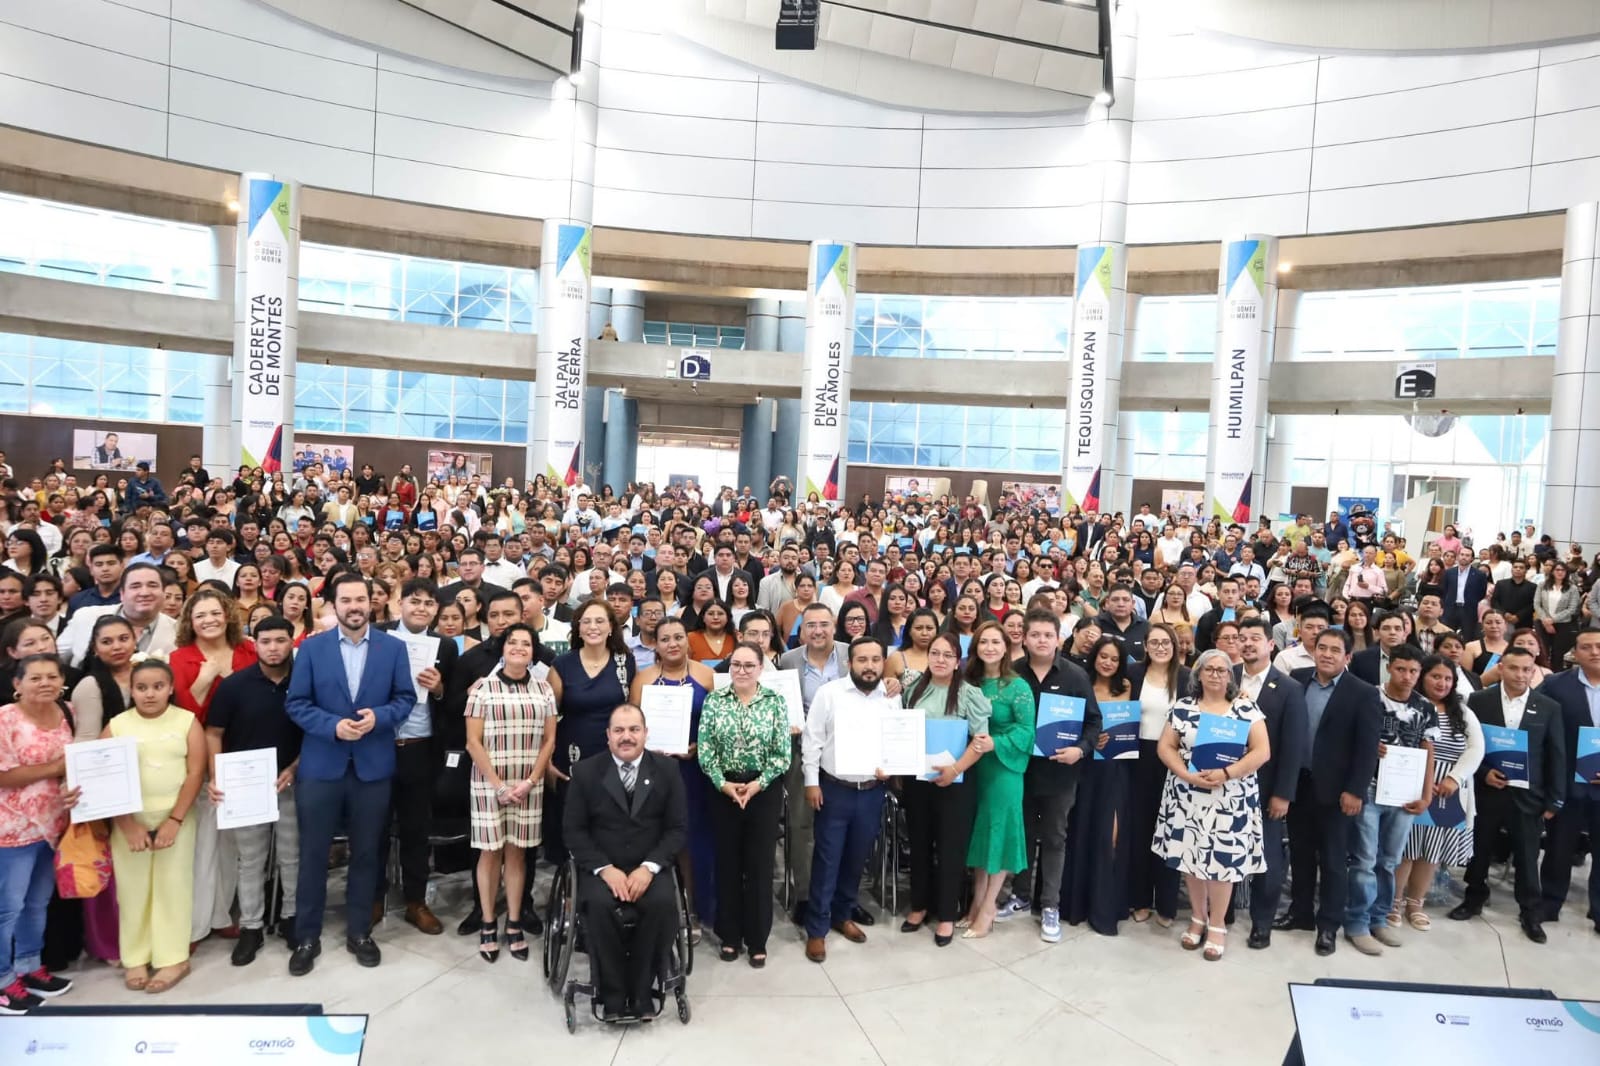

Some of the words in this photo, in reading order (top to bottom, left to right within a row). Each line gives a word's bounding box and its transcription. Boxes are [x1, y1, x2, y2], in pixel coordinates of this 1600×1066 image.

[248, 294, 266, 395] CADEREYTA
[266, 296, 282, 368] MONTES
[555, 351, 570, 409] JALPAN
[569, 337, 582, 384] SERRA
[683, 359, 700, 378] D
[827, 341, 841, 403] AMOLES
[265, 374, 280, 396] DE
[567, 390, 580, 410] DE
[814, 383, 828, 427] PINAL
[1077, 331, 1097, 457] TEQUISQUIAPAN
[1227, 349, 1246, 439] HUIMILPAN
[1400, 375, 1417, 397] E
[825, 407, 838, 427] DE
[249, 1038, 296, 1050] CONTIGO
[1525, 1017, 1564, 1027] CONTIGO
